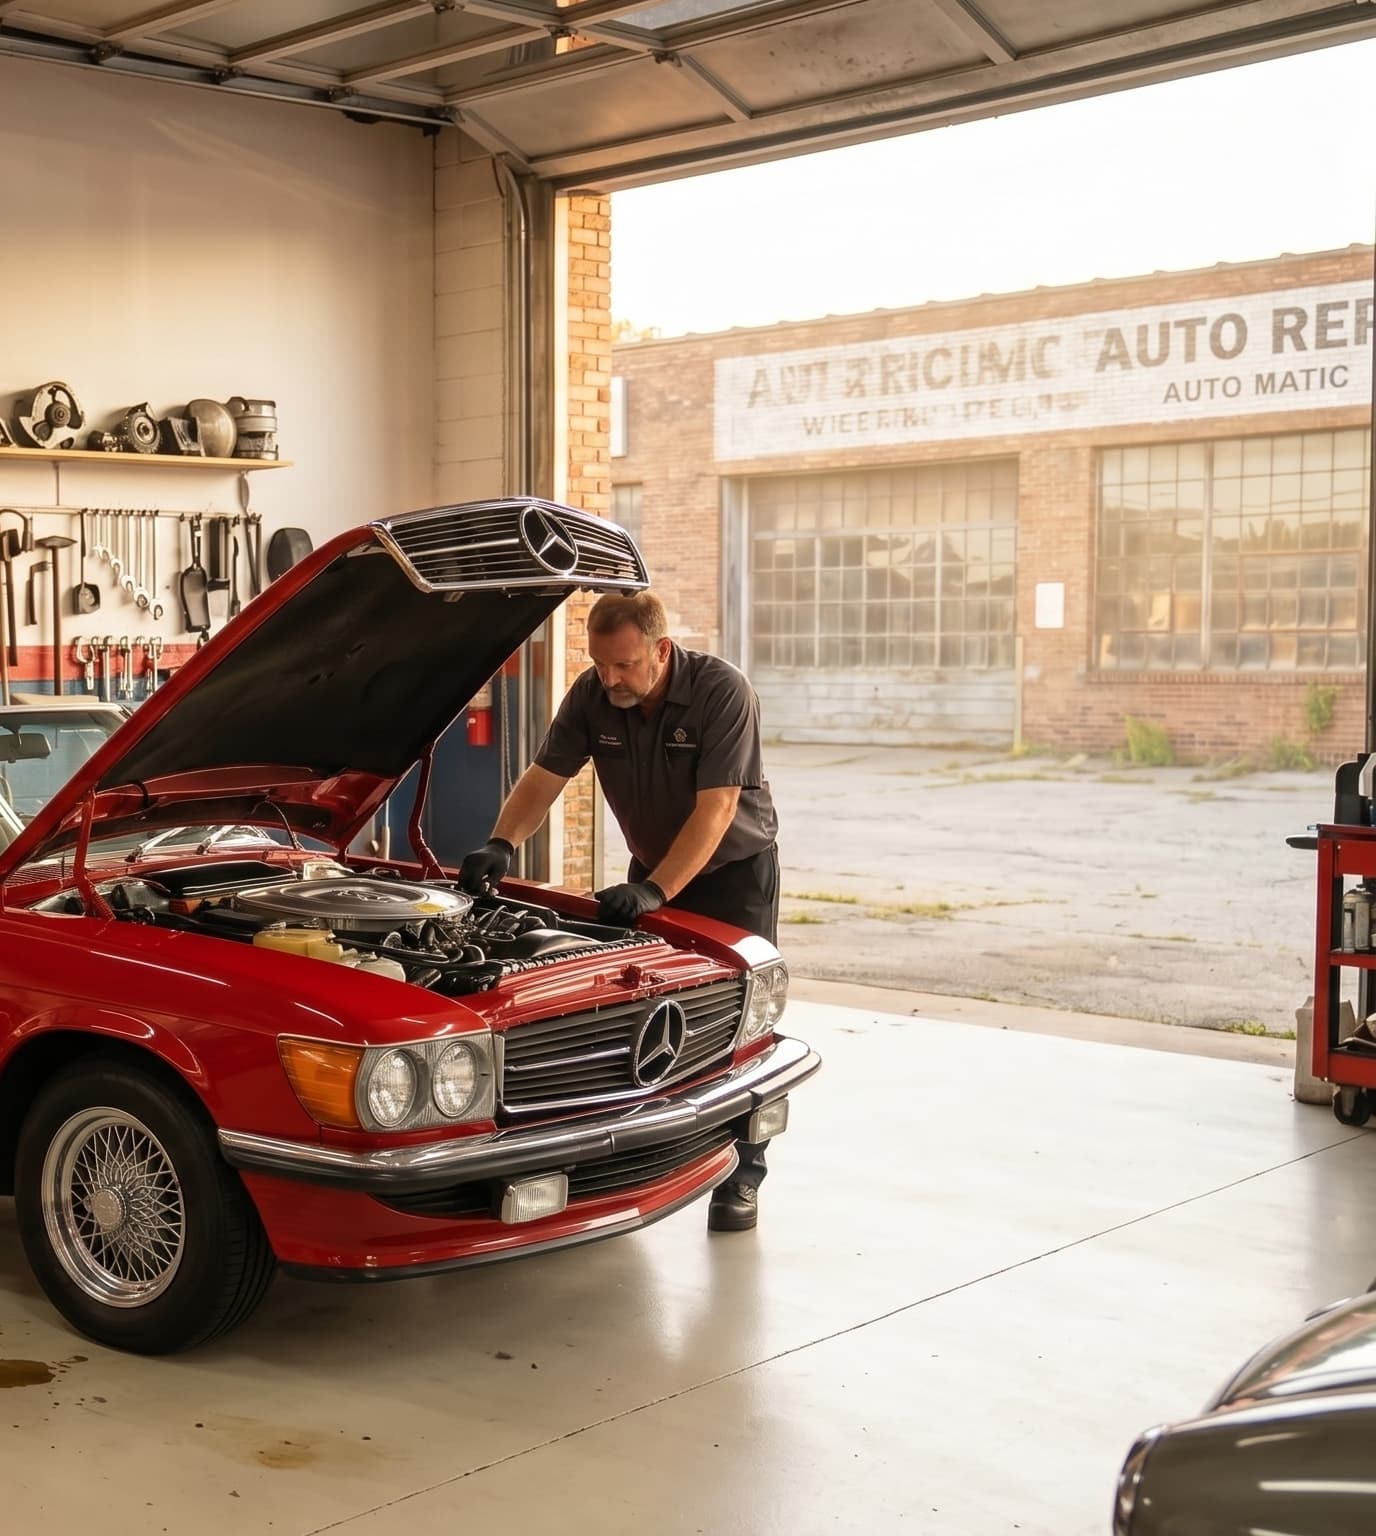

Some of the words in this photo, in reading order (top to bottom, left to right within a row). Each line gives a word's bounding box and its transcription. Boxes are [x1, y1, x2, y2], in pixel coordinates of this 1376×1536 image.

[1095, 313, 1248, 373] AUTO
[1162, 376, 1242, 404] AUTO
[1254, 365, 1349, 396] MATIC
